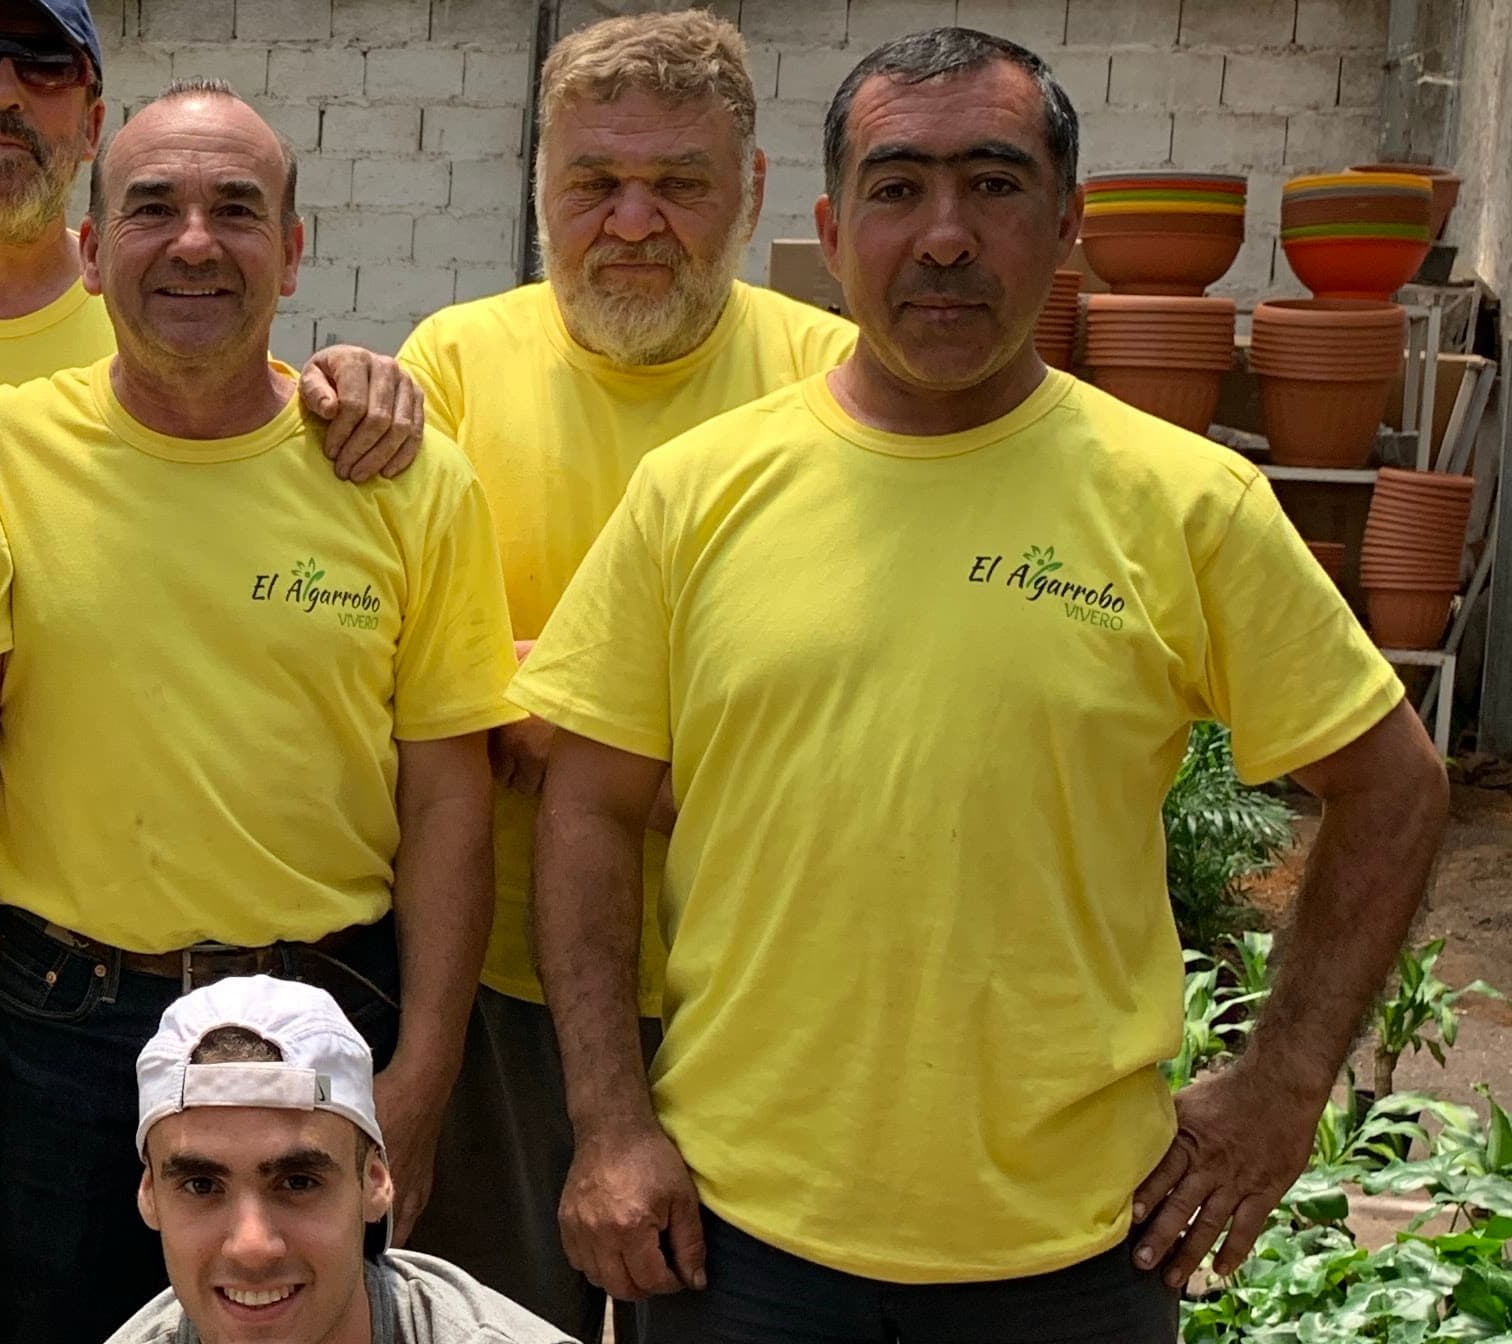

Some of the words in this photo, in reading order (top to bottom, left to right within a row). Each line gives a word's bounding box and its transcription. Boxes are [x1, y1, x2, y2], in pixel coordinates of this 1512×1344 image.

[252, 573, 279, 600] El
[286, 570, 380, 613] Algarrobo
[969, 555, 1002, 583] El
[1006, 562, 1125, 613] Algarrobo
[337, 613, 379, 630] VIVERO
[1065, 603, 1123, 631] VIVERO
